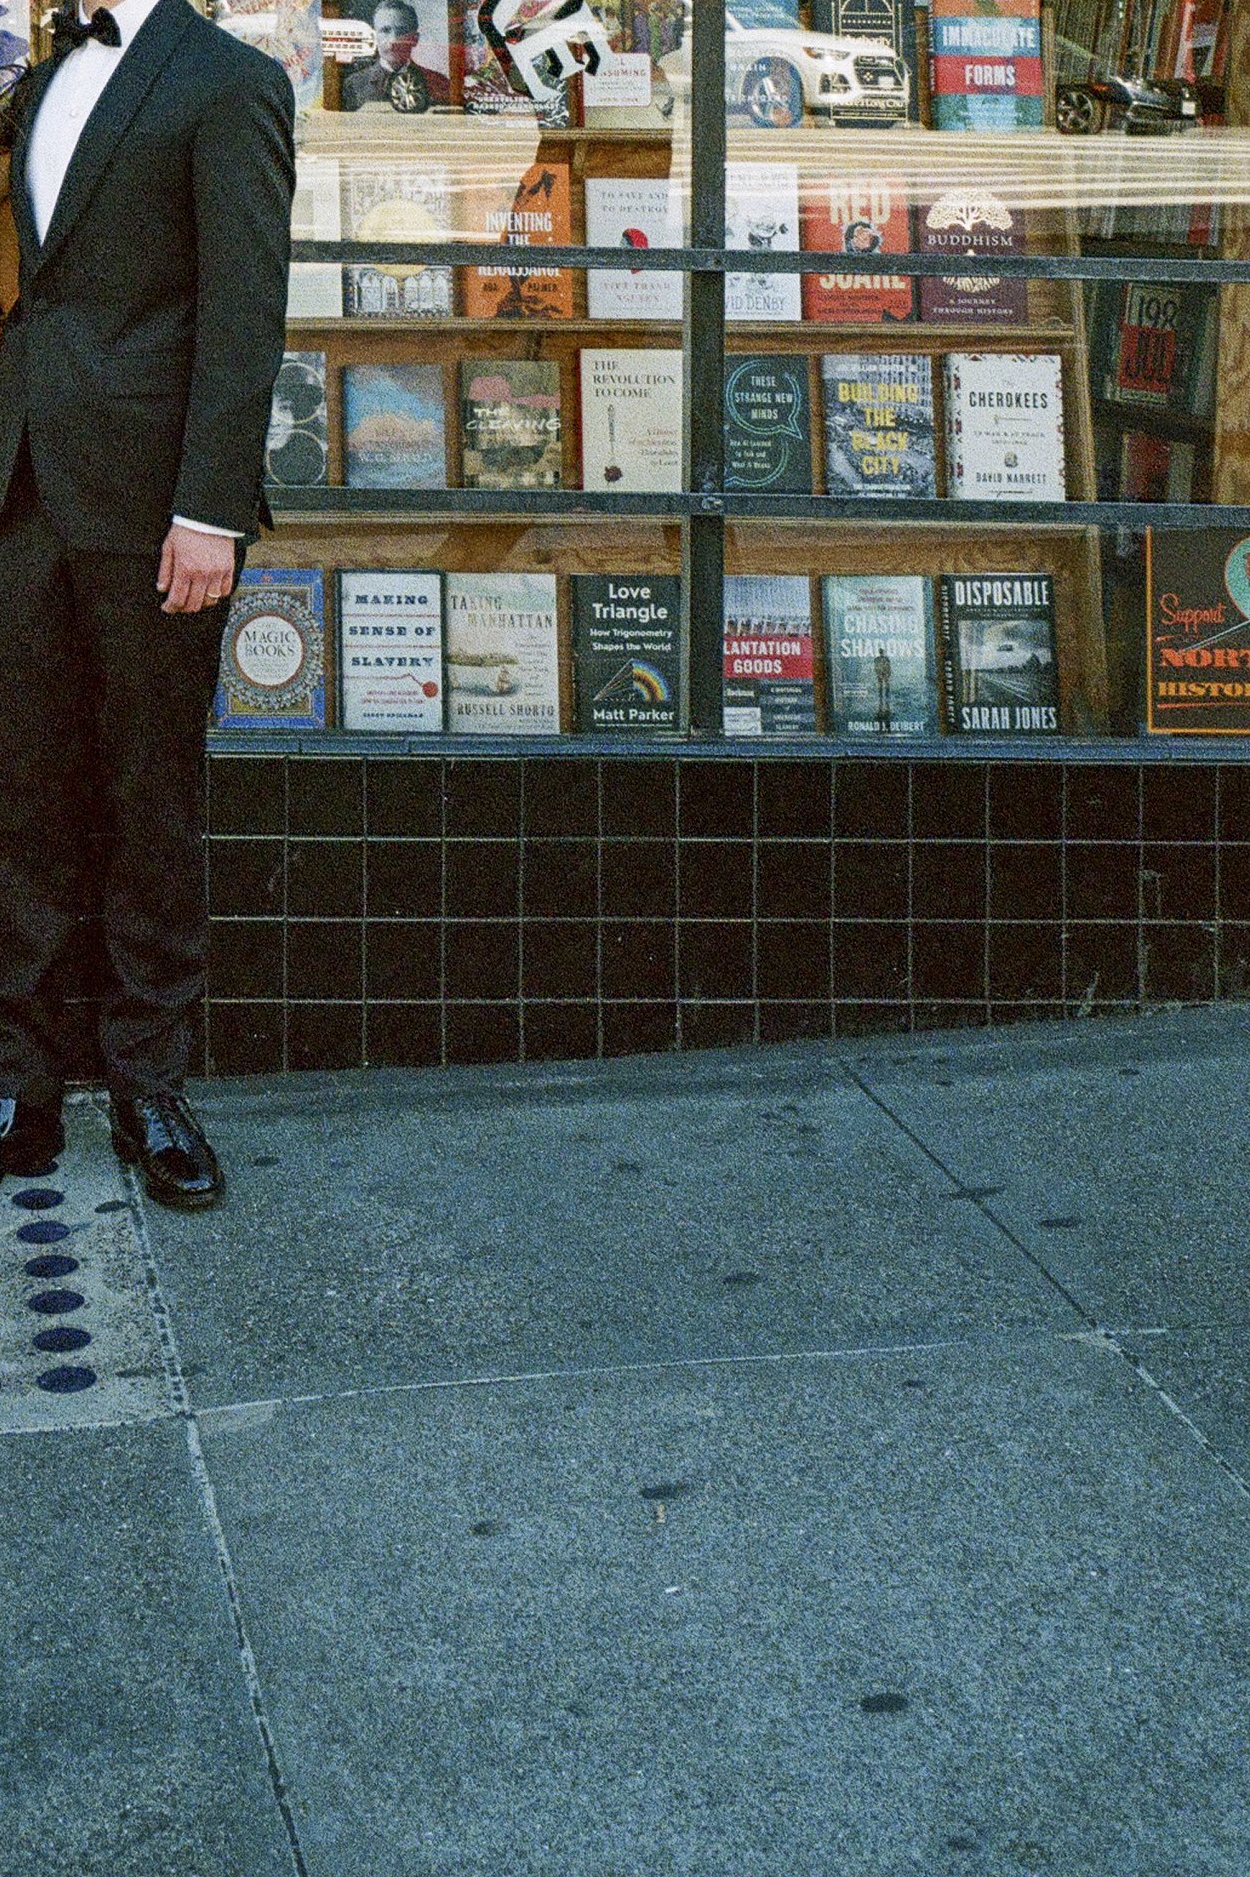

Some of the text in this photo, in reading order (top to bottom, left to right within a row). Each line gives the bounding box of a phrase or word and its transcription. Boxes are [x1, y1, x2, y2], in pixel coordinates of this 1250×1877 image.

[943, 25, 1036, 49] IMMACULATE
[964, 64, 1016, 87] FORMS
[828, 182, 892, 225] RED
[486, 211, 552, 232] INVENTING
[927, 233, 1014, 247] BUDDHISM
[746, 295, 785, 312] DENBY
[593, 361, 619, 371] THE
[593, 374, 676, 385] REVOLUTION
[750, 375, 777, 388] THESE
[594, 387, 651, 399] TO COME
[734, 391, 794, 403] STRANGE NEW
[838, 382, 919, 402] BUILDING
[968, 391, 1048, 409] CHEROKEES
[473, 407, 511, 417] THE
[750, 408, 779, 421] MINDS
[862, 408, 896, 426] THE
[466, 418, 561, 432] CLEAVING
[850, 433, 908, 451] BLACK
[860, 456, 900, 475] CITY
[976, 472, 1003, 484] DAVID
[609, 583, 651, 599] Love
[954, 581, 1049, 606] DISPOSABLE
[355, 594, 429, 606] MAKING
[450, 595, 502, 611] TAKING
[592, 603, 669, 624] Triangle
[1159, 592, 1226, 632] Support
[467, 613, 552, 630] MANHATTAN
[843, 615, 919, 634] CHASING
[243, 629, 295, 644] MAGIC
[349, 625, 437, 637] SENSE OF
[589, 629, 673, 639] How Trigonometry
[245, 643, 296, 658] BOOKS
[592, 642, 672, 652] Shapes the World
[723, 641, 801, 655] LANTATION
[840, 638, 925, 658] SHADOWS
[351, 656, 434, 668] SLAVERY
[733, 659, 783, 674] GOODS
[456, 703, 506, 717] RUSSELL
[593, 709, 675, 721] Matt Parker
[961, 706, 1058, 730] SARAH JONES
[847, 721, 880, 732] RONALD
[890, 721, 925, 732] DEIBERT
